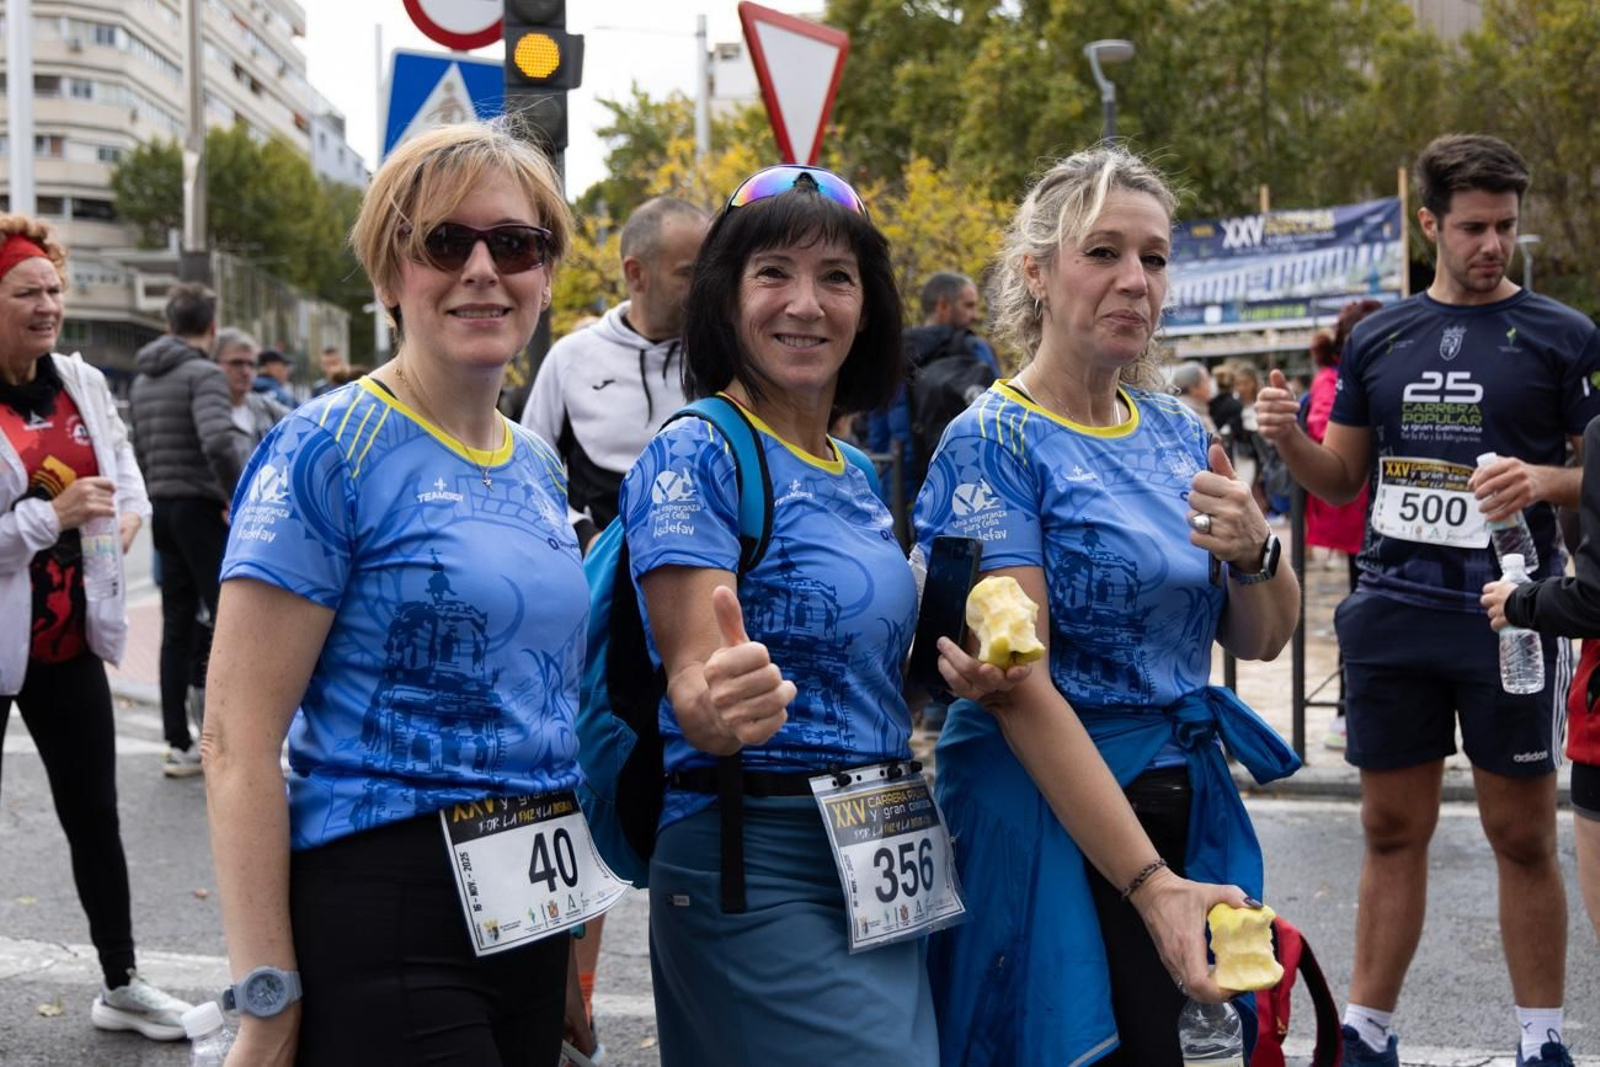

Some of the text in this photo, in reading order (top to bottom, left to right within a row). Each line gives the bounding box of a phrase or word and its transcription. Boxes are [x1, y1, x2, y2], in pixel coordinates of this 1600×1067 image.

[1220, 215, 1265, 249] XXV
[1403, 371, 1484, 404] 25
[1402, 403, 1481, 414] CARRERA
[1402, 413, 1483, 425] POPULAR
[1386, 462, 1409, 477] XXV
[1399, 492, 1468, 527] 500
[1513, 750, 1548, 762] adidas
[831, 798, 866, 828] XXV
[883, 804, 906, 820] gran
[459, 851, 472, 872] 2025
[528, 827, 579, 893] 40
[873, 837, 934, 903] 356
